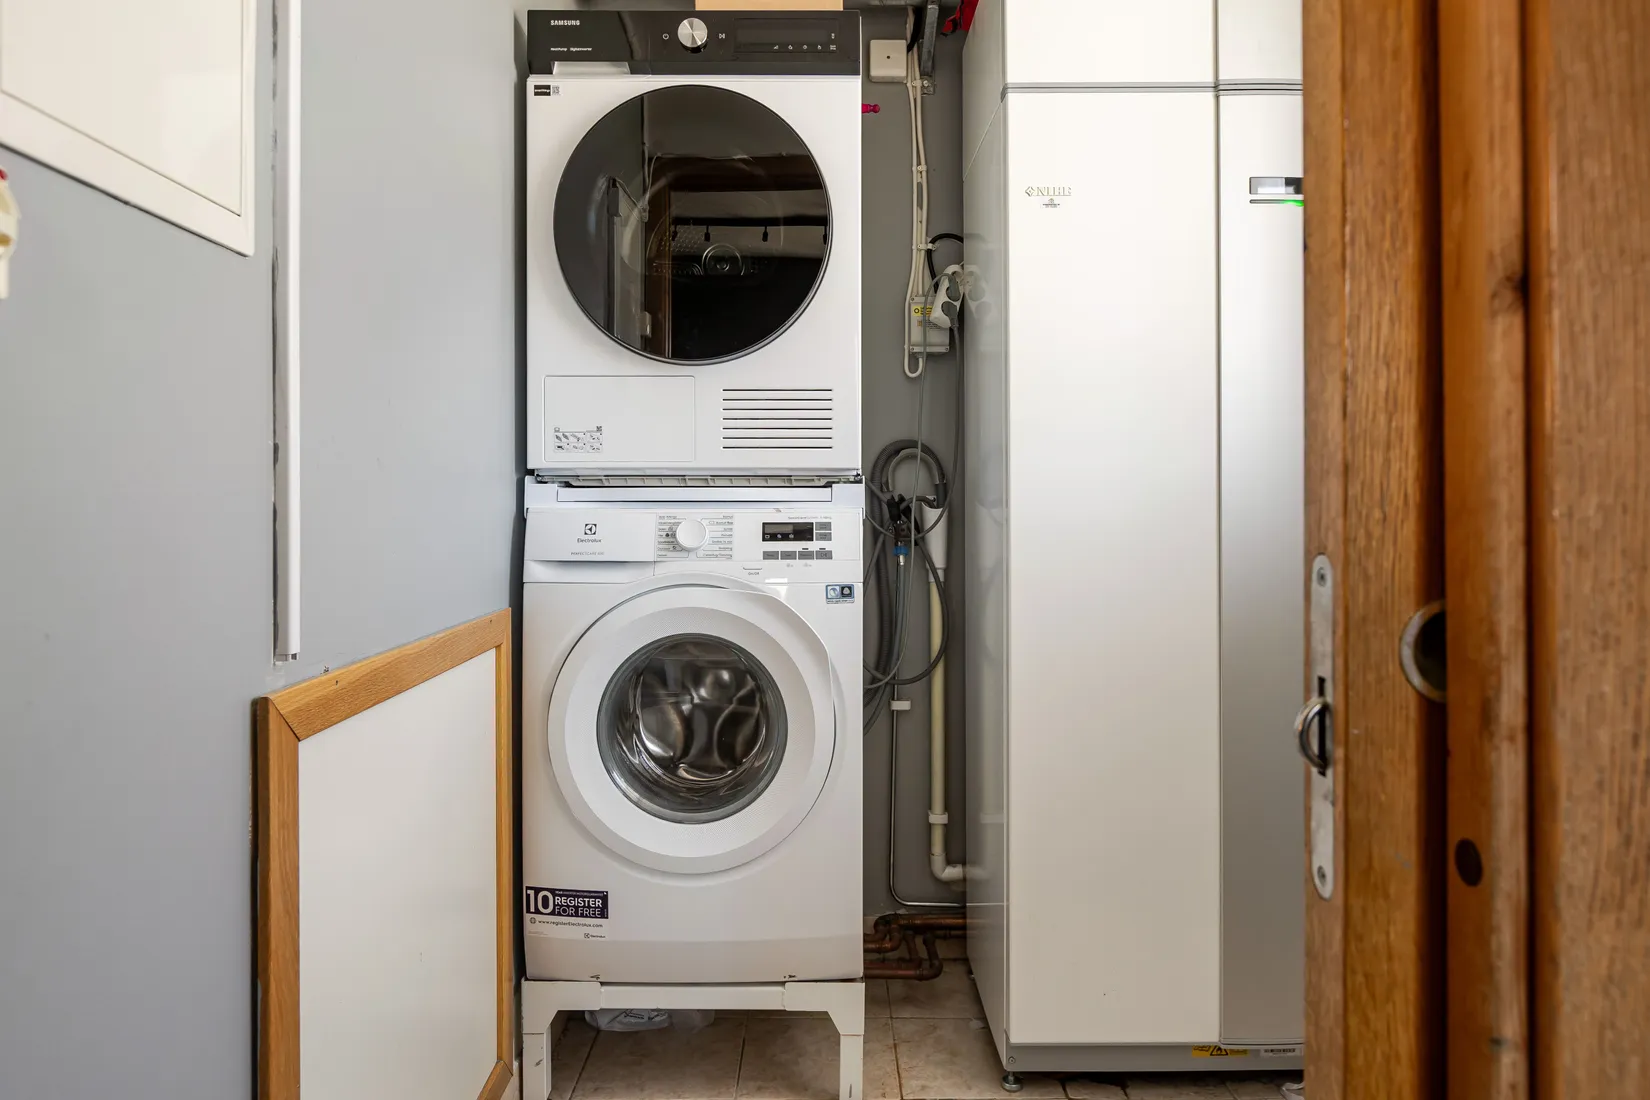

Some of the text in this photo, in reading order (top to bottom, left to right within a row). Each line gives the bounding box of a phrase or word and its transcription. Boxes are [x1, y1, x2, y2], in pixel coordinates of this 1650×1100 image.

[527, 890, 553, 914] 10
[555, 896, 602, 907] REGISTER
[555, 906, 575, 916] FOR
[578, 908, 602, 917] FREE
